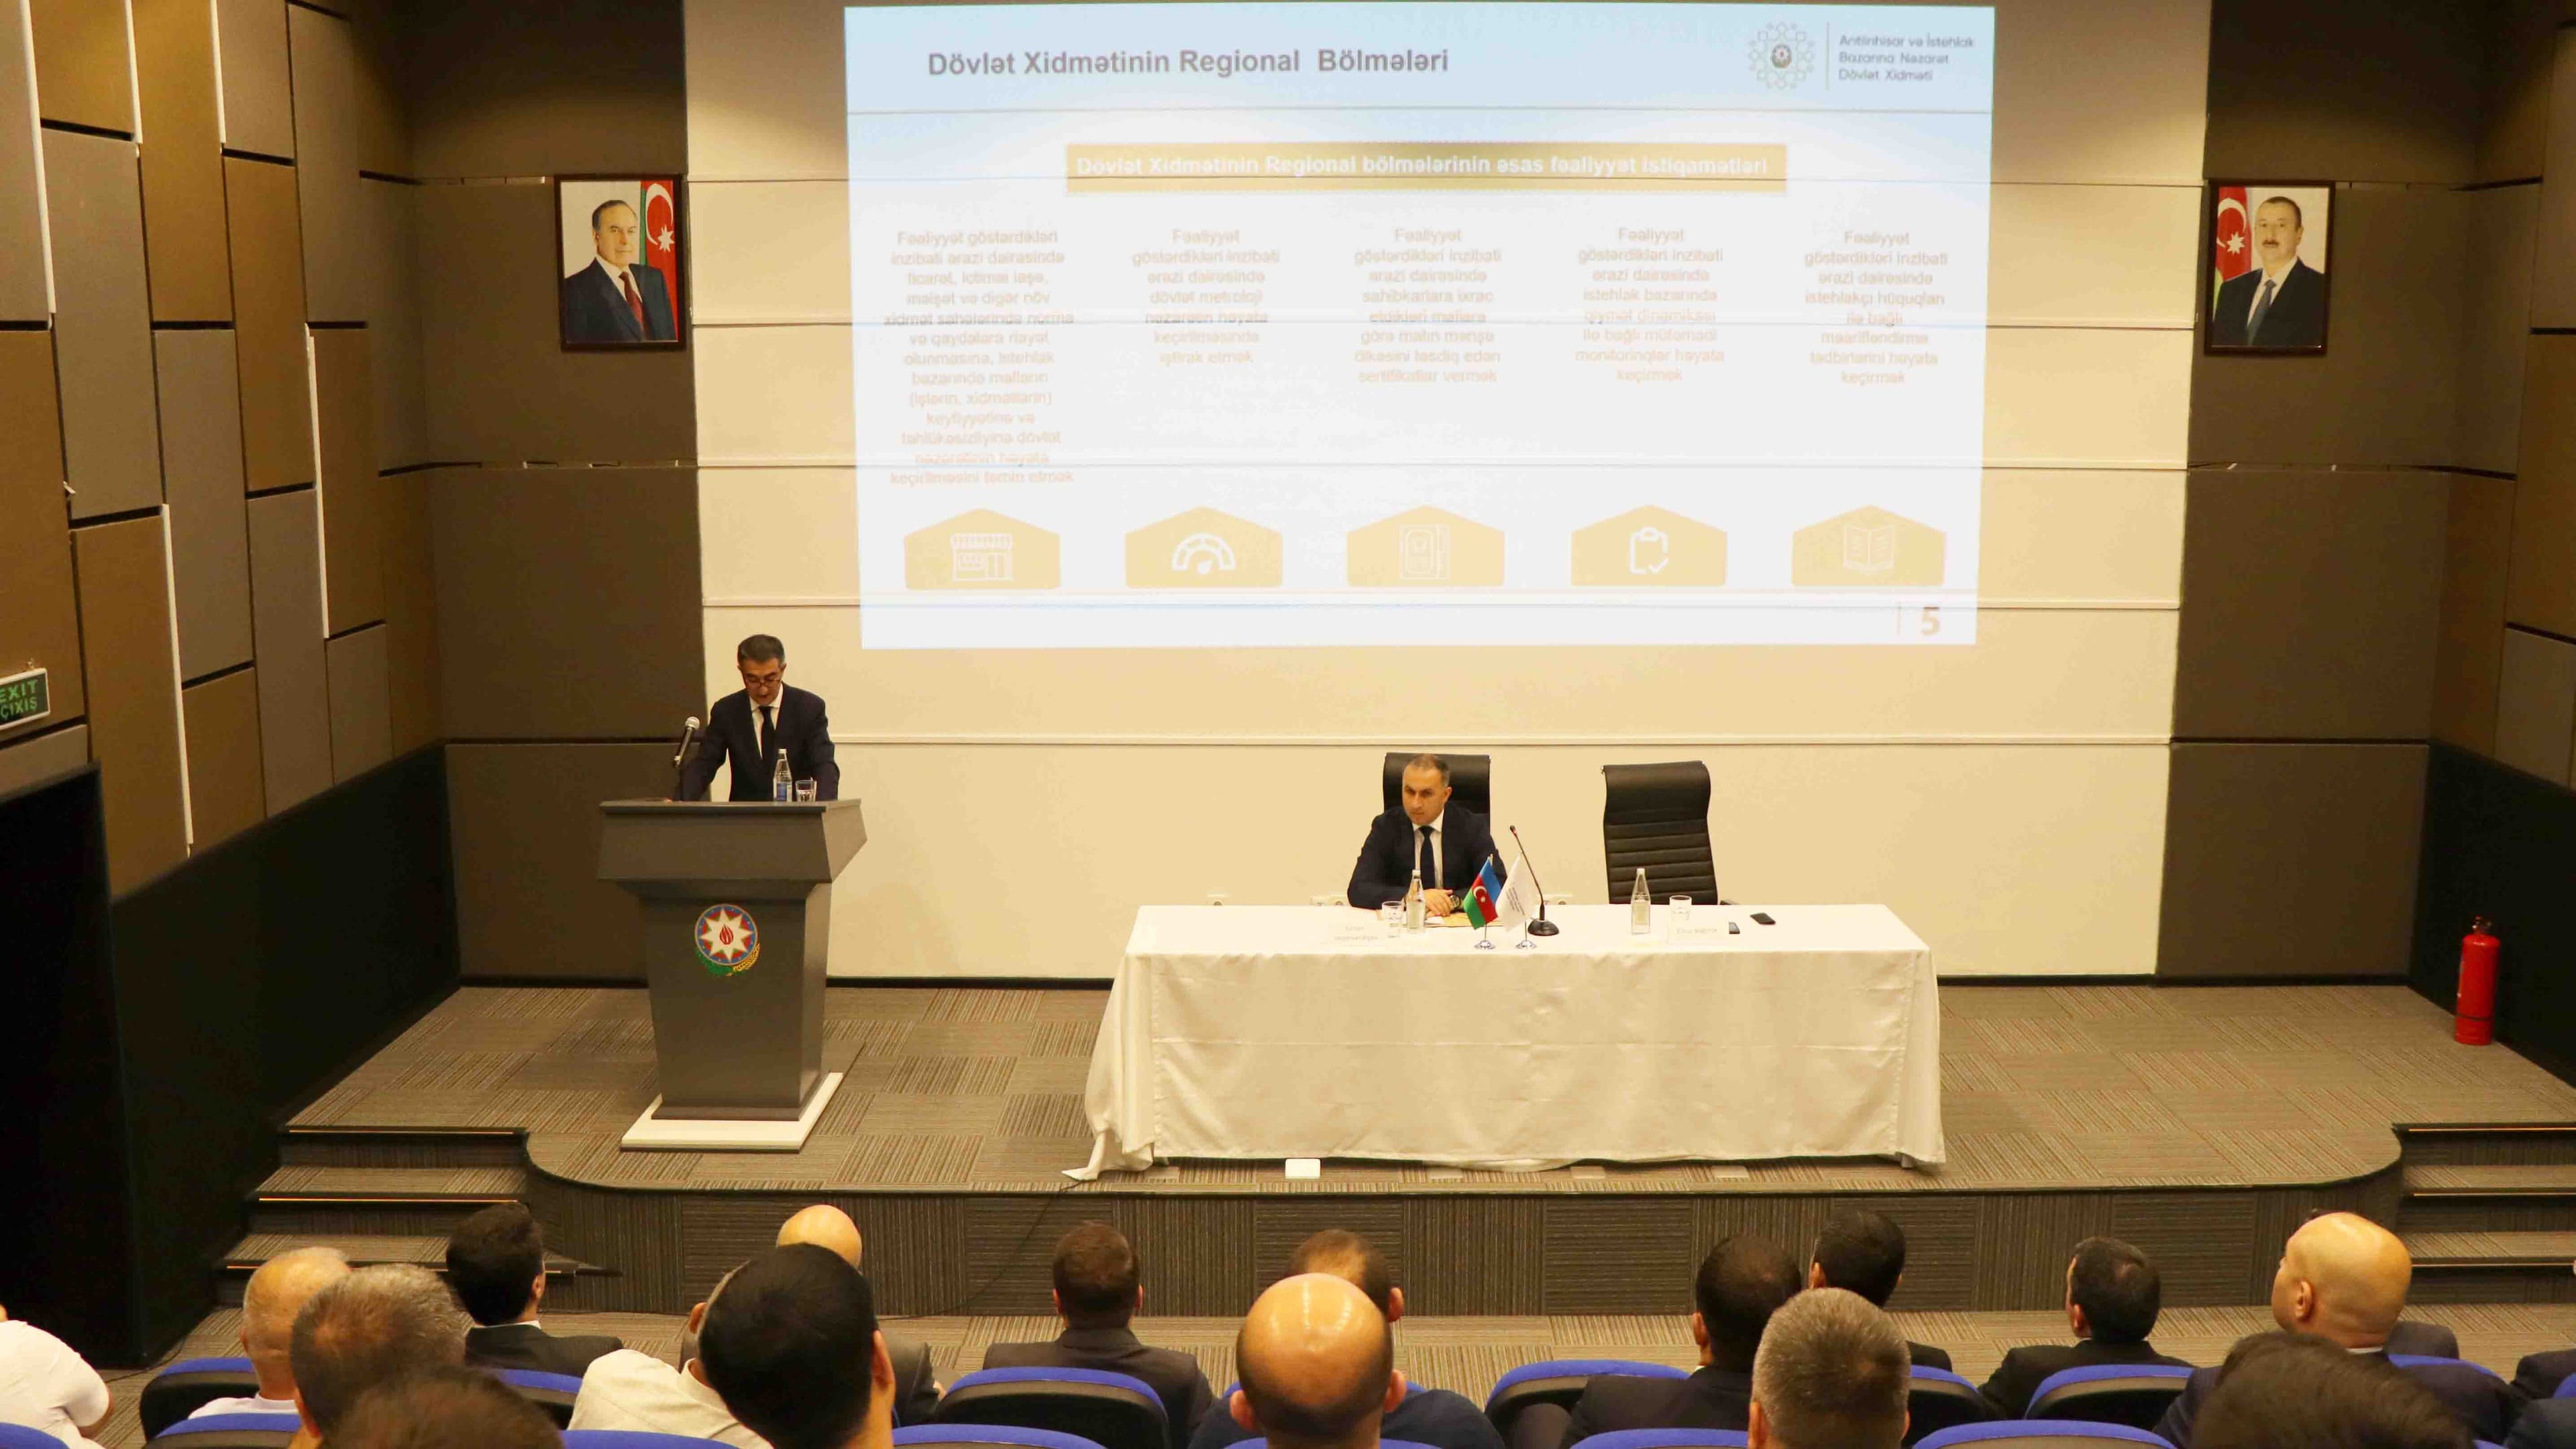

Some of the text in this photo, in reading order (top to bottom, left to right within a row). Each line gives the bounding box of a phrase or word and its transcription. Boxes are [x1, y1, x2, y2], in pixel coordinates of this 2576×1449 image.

[1909, 38, 1923, 47] və
[928, 50, 1448, 78] Dövlət Xidmətinin Regional Bölmələri
[1839, 68, 1933, 80] Dövlət Xidməti
[1077, 156, 1767, 177] Dövlət Xidmətinin Regional bölmələrinin əsas fəaliyyət istiqamətləri
[1921, 605, 1940, 637] 5
[0, 679, 38, 703] EXIT
